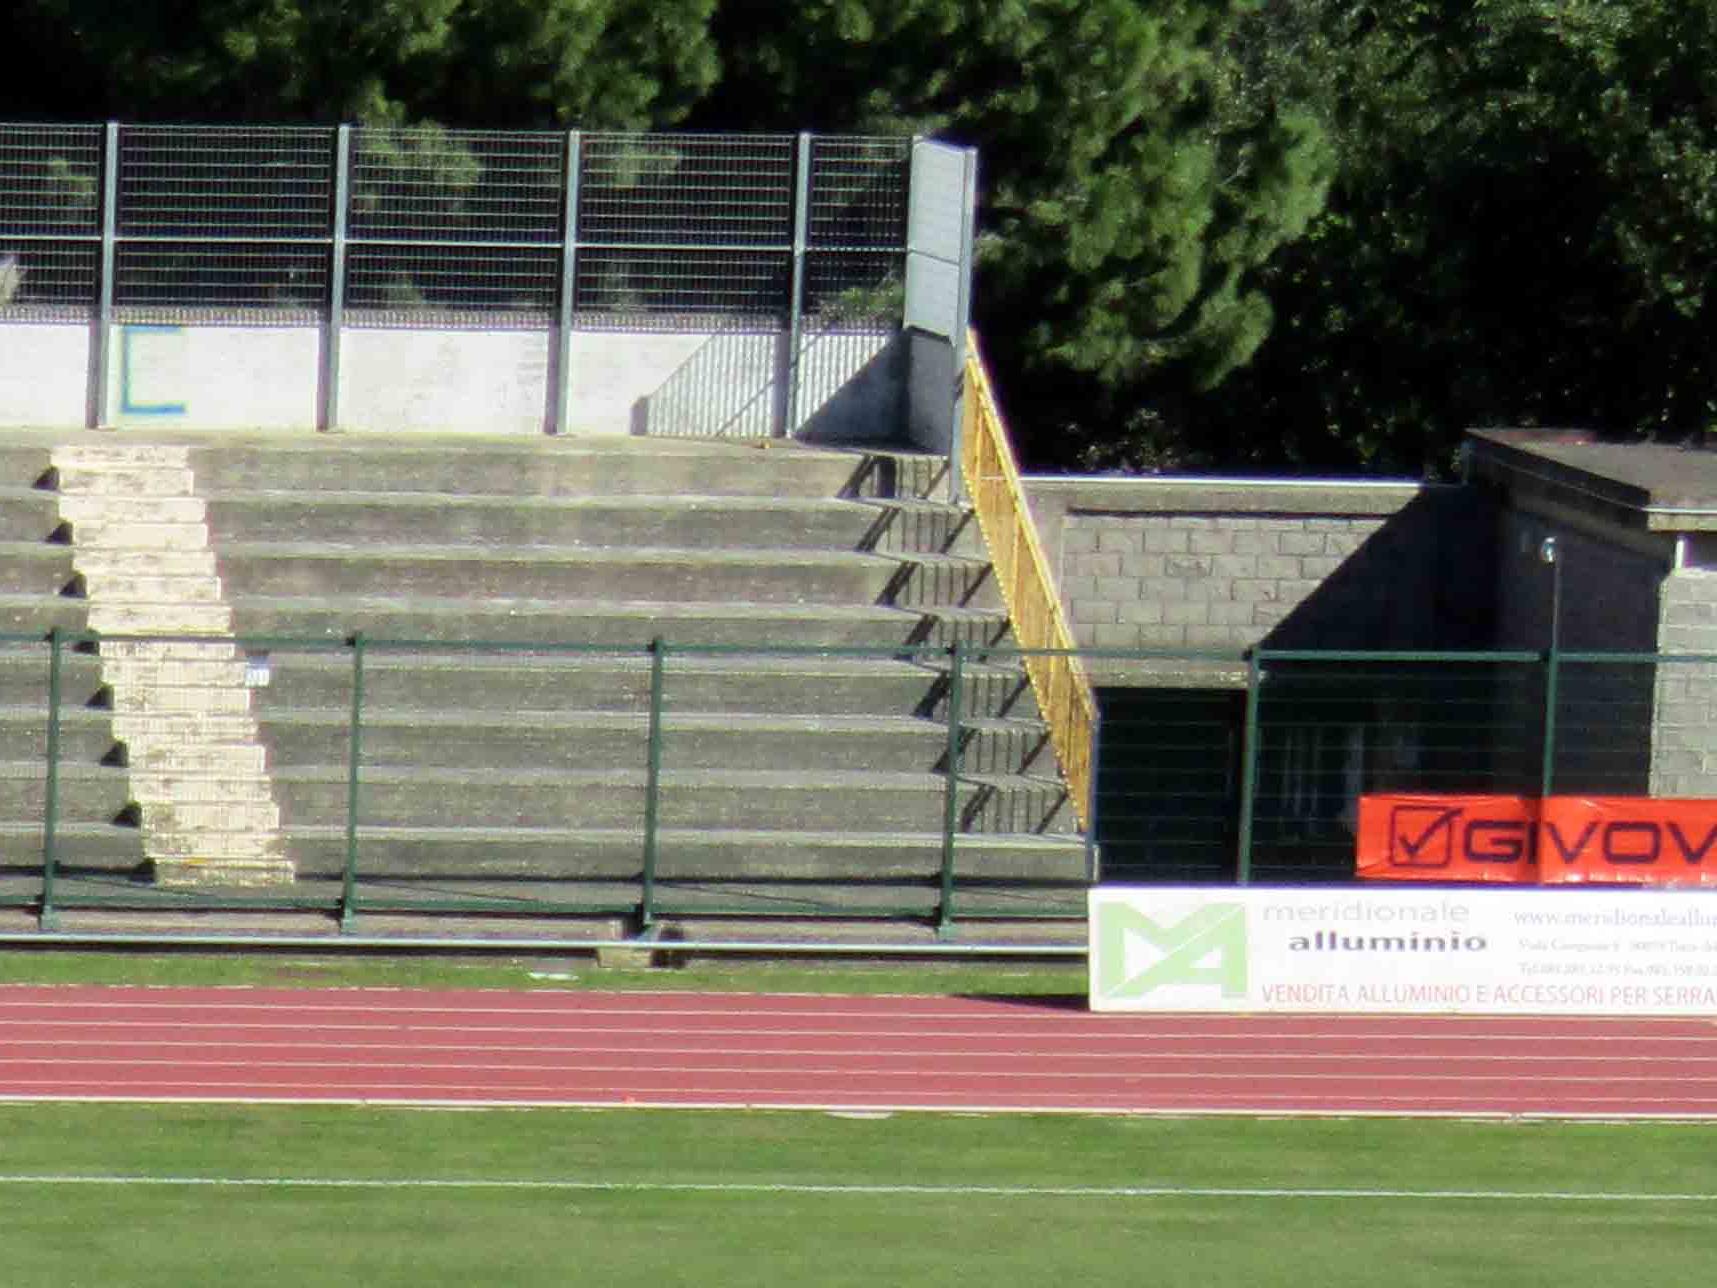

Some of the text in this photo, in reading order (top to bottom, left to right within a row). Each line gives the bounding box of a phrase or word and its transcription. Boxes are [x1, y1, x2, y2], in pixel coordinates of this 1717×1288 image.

[1263, 898, 1469, 921] meridionale
[1287, 928, 1487, 952] alluminio
[1262, 985, 1349, 1003] VENDITA
[1356, 985, 1470, 1003] ALLUMINIO
[1493, 985, 1604, 1004] ACCESSORI
[1610, 986, 1647, 1004] PER
